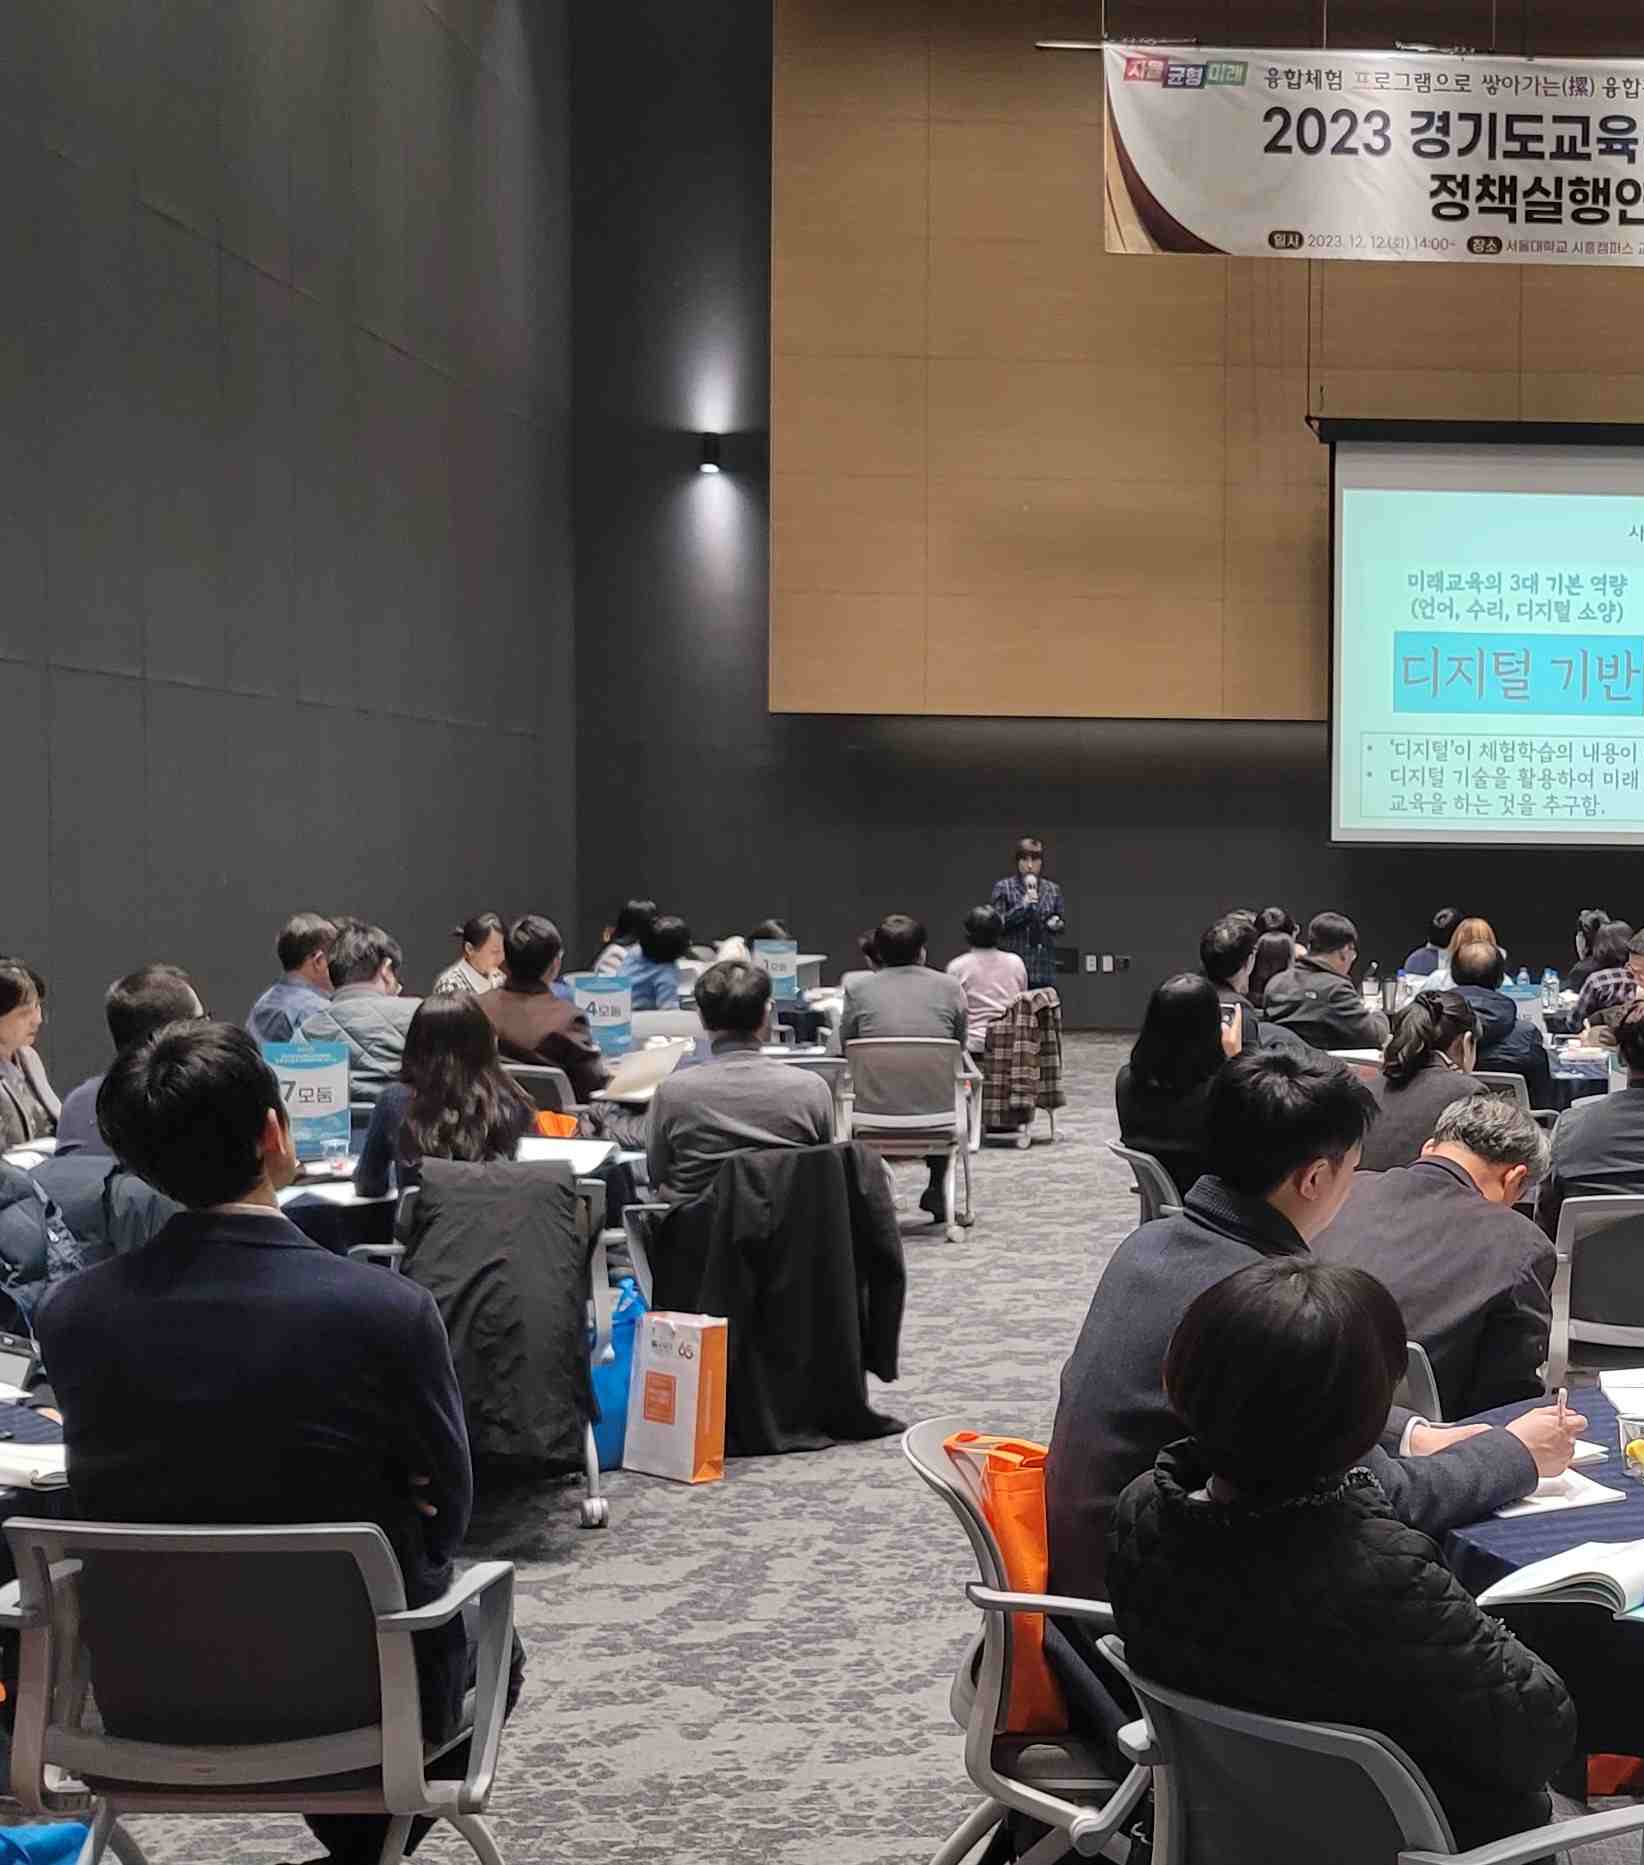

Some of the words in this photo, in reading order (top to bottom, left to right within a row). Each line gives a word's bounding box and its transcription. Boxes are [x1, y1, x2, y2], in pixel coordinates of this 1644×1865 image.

[1167, 66, 1204, 86] 균형
[1207, 63, 1244, 82] 미래
[1264, 67, 1343, 92] 융합체험
[1352, 70, 1472, 94] 프로그램으로
[1262, 106, 1392, 157] 2023
[1272, 232, 1300, 249] 일시
[1471, 239, 1500, 253] 장소
[1506, 240, 1568, 254] 서울대학교
[1572, 241, 1634, 255] 시흥캠퍼스
[1407, 570, 1502, 595] 미래교육의
[1509, 571, 1539, 595] 3대
[1546, 572, 1584, 596] 기본
[1590, 573, 1629, 598] 역량
[1410, 596, 1460, 622] (언어,
[1466, 598, 1510, 622] 수리,
[1517, 599, 1571, 623] 디지털
[1577, 600, 1624, 624] 소양)
[1401, 648, 1532, 703] 디지털
[1550, 647, 1641, 703] 기반
[1479, 741, 1573, 764] 체험학습의
[1582, 742, 1638, 766] 내용이
[1390, 766, 1444, 788] 디지털
[1452, 766, 1511, 789] 기술을
[1517, 767, 1595, 791] 활용하여
[1603, 769, 1639, 791] 미래
[1389, 793, 1447, 815] 교육을
[1453, 794, 1493, 815] 하는
[1498, 794, 1537, 816] 것을
[1541, 795, 1606, 817] 추구함.
[280, 1080, 333, 1103] 7모둠
